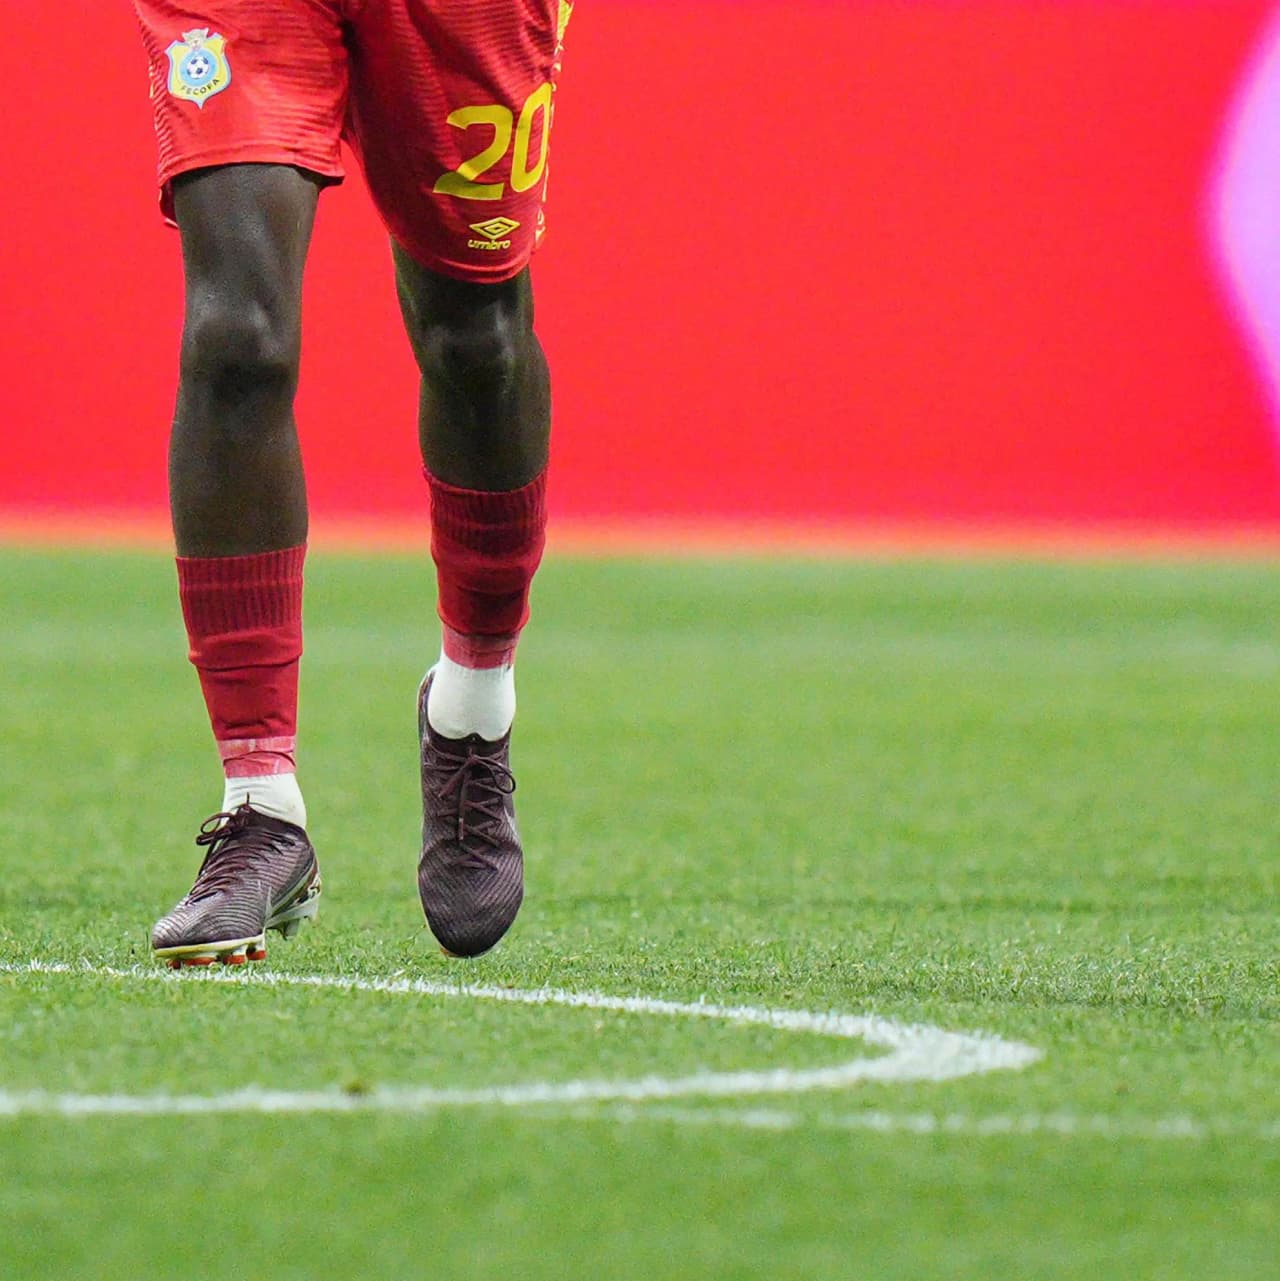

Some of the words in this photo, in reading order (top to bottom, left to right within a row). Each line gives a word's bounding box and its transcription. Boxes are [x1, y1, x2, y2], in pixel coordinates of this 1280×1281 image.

[180, 79, 220, 96] FECOFA
[432, 82, 551, 201] 20
[467, 239, 511, 250] umbro
